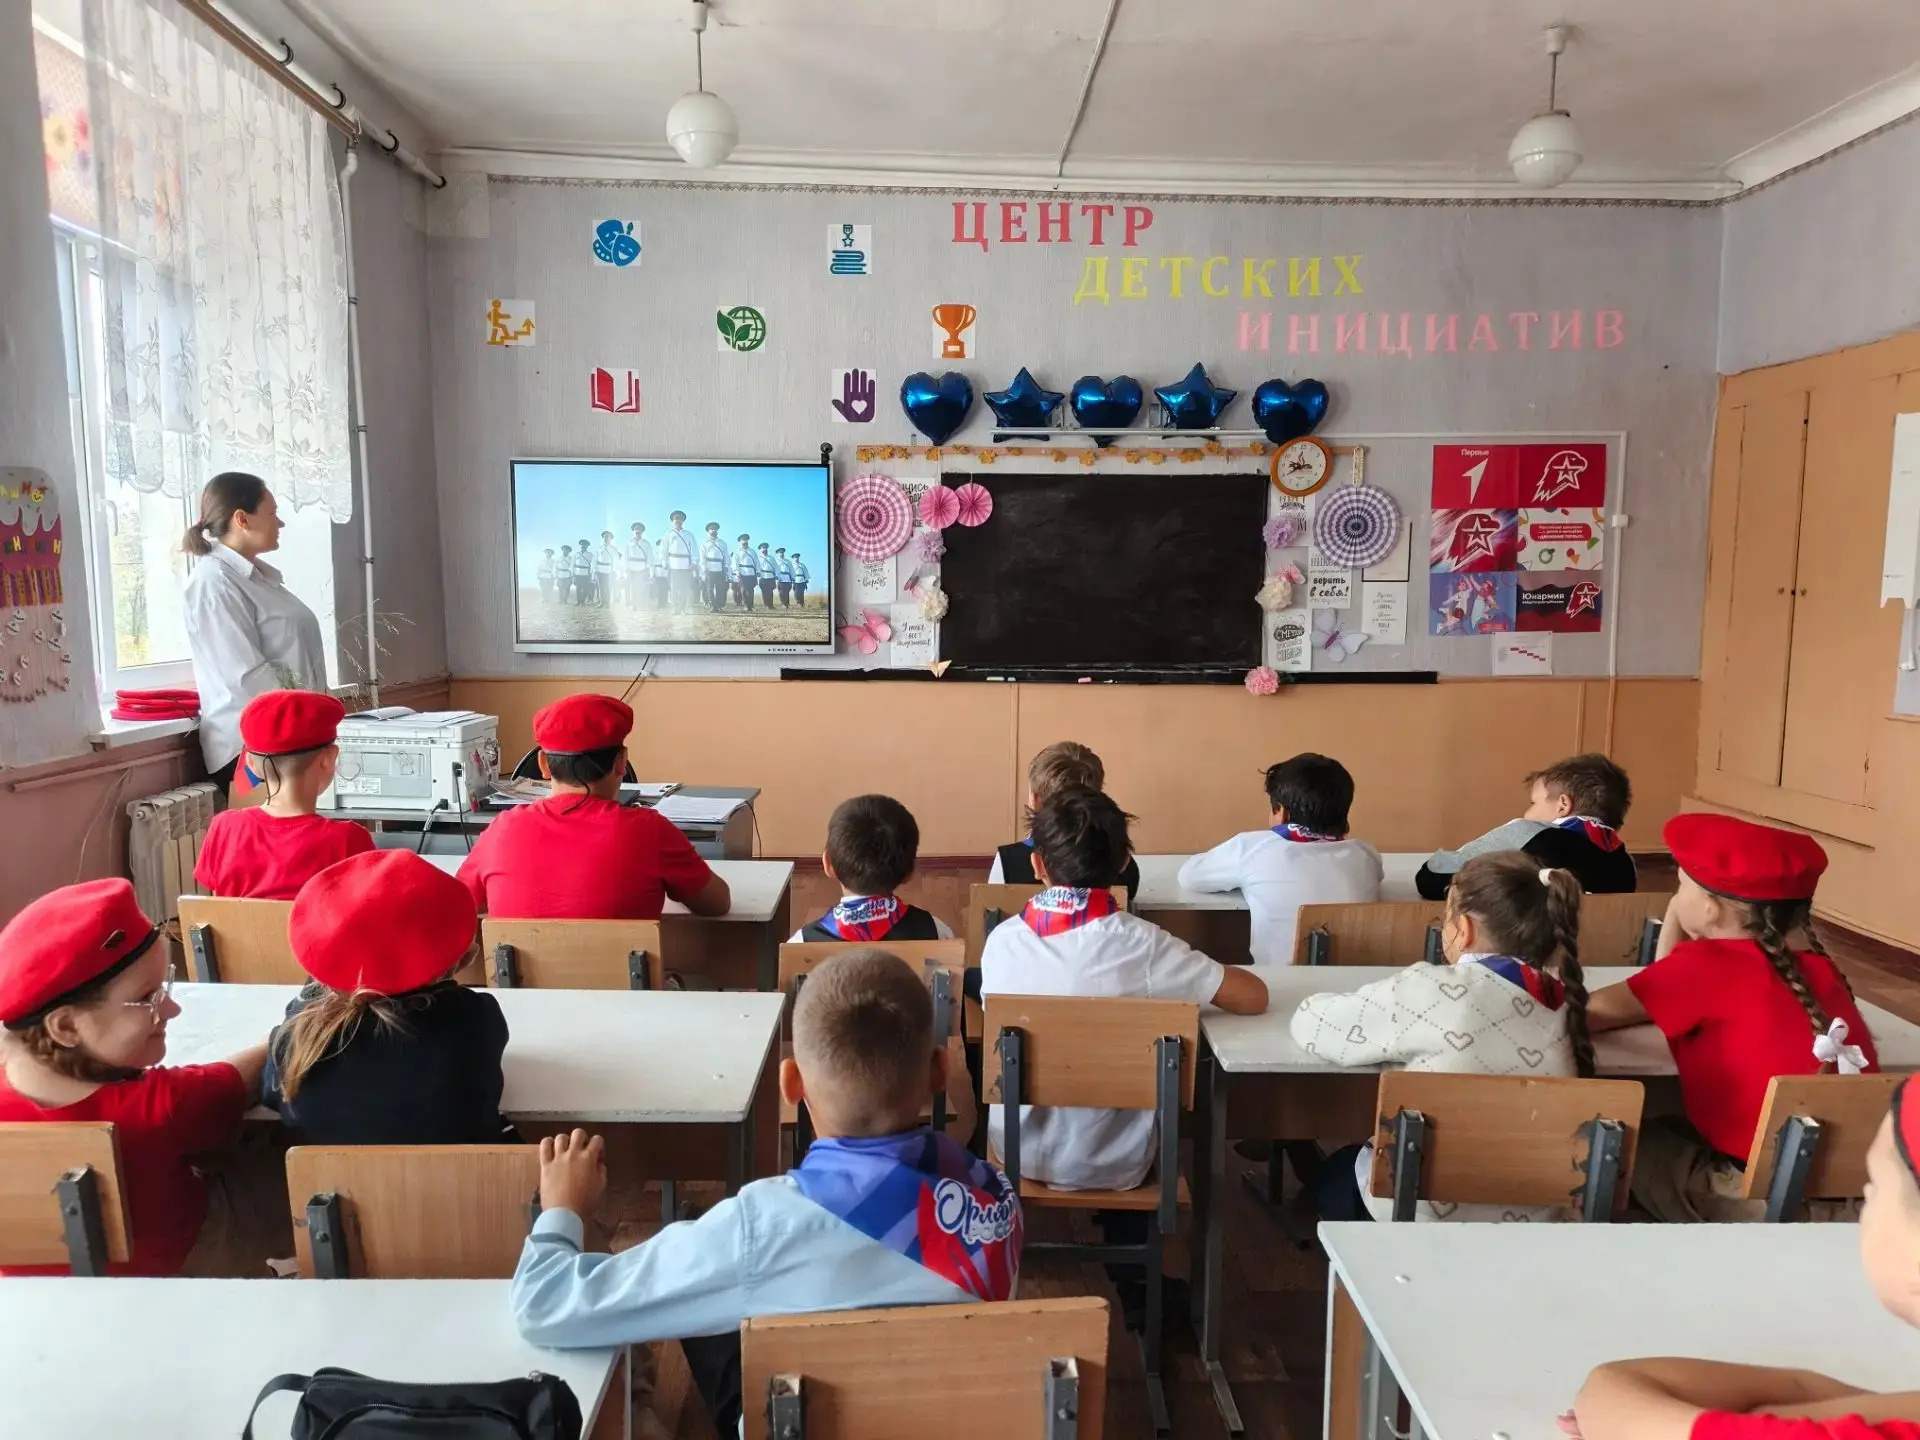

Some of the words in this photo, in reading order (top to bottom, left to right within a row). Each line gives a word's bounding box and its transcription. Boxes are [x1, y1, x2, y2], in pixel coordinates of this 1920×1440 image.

[952, 202, 1154, 252] ЦЕНТР
[1074, 255, 1364, 306] ДЕТСКИХ
[1236, 309, 1626, 359] ИНИЦИАТИВ
[1461, 448, 1490, 457] Первые
[1313, 577, 1346, 587] верить
[1309, 586, 1317, 597] в
[1319, 585, 1349, 597] себя!
[1522, 592, 1565, 601] Юнармия
